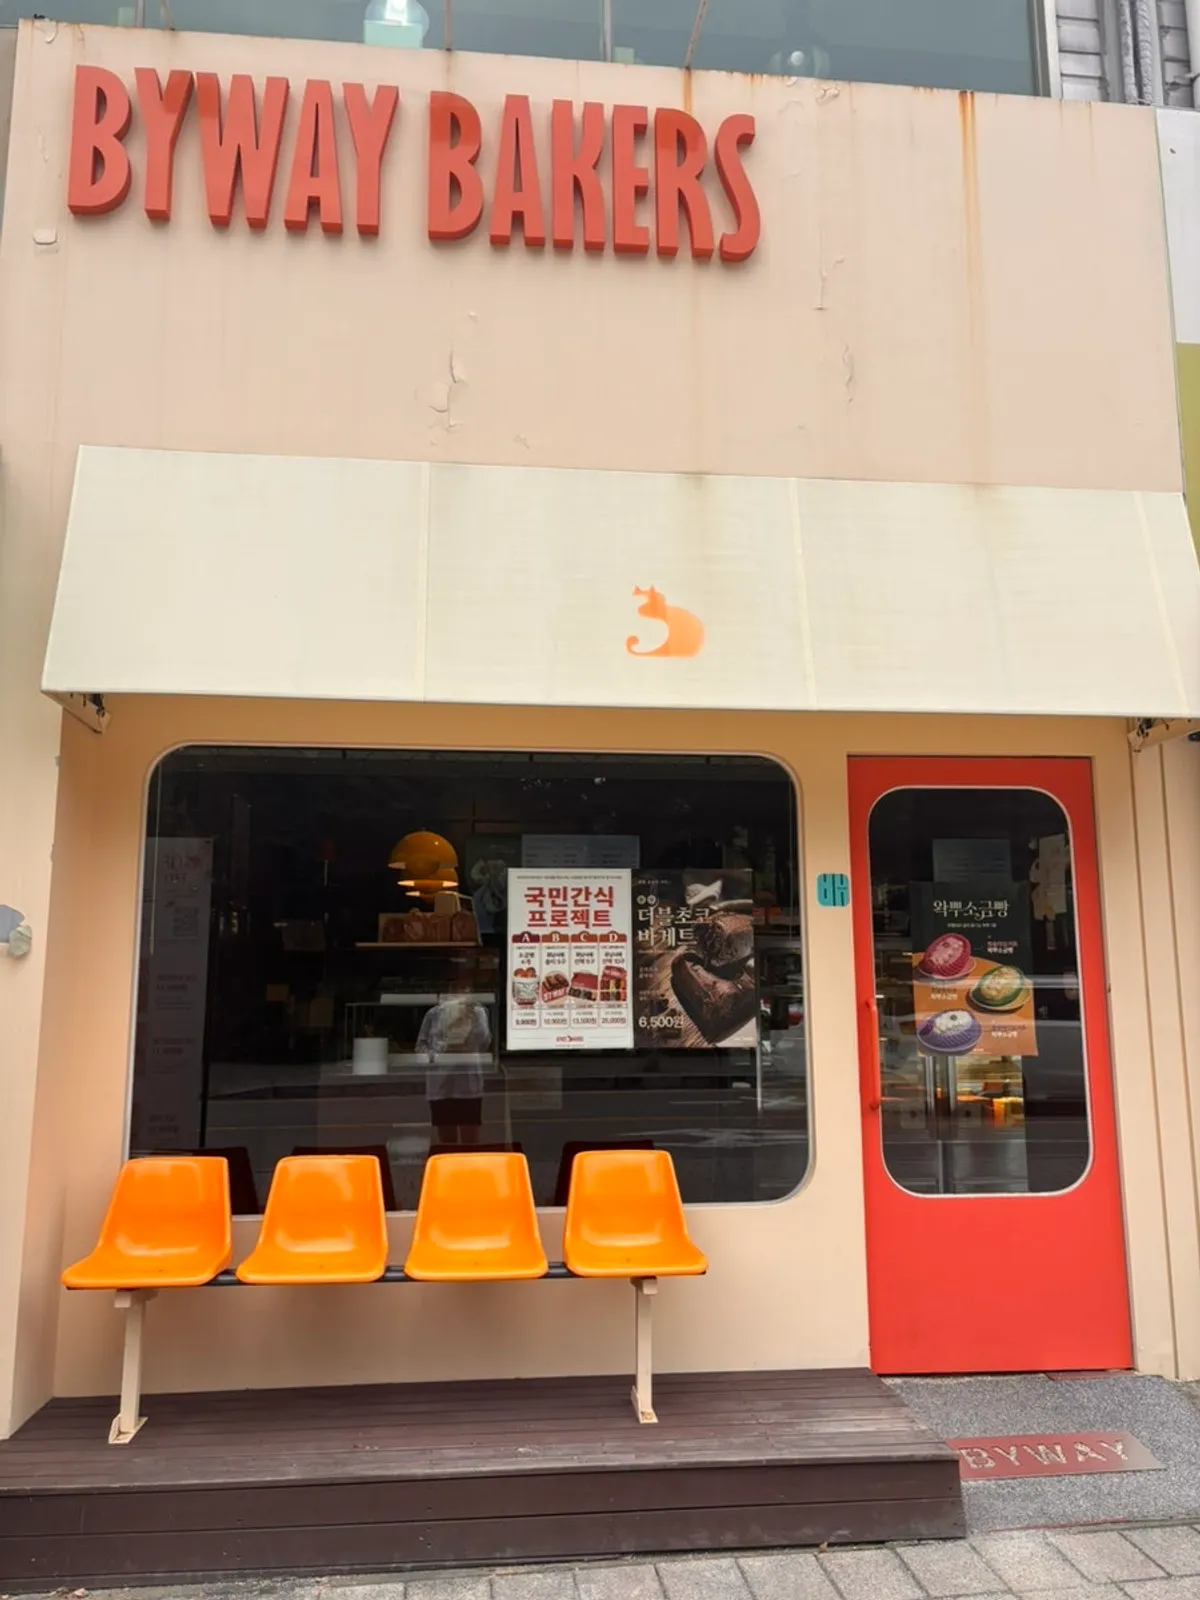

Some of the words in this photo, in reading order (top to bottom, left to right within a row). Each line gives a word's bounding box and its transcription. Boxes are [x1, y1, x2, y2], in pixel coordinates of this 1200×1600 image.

[67, 64, 399, 237] BYWAY
[428, 90, 761, 262] BAKERS
[524, 886, 613, 907] 국민간식
[527, 909, 612, 928] 프로젝트
[638, 906, 712, 926] 더블초코
[521, 933, 530, 943] A
[551, 933, 560, 942] B
[580, 932, 588, 942] C
[609, 932, 618, 942] D
[637, 927, 697, 946] 바게트
[638, 1015, 684, 1030] 6,500원
[958, 1439, 1129, 1469] BYWAY
